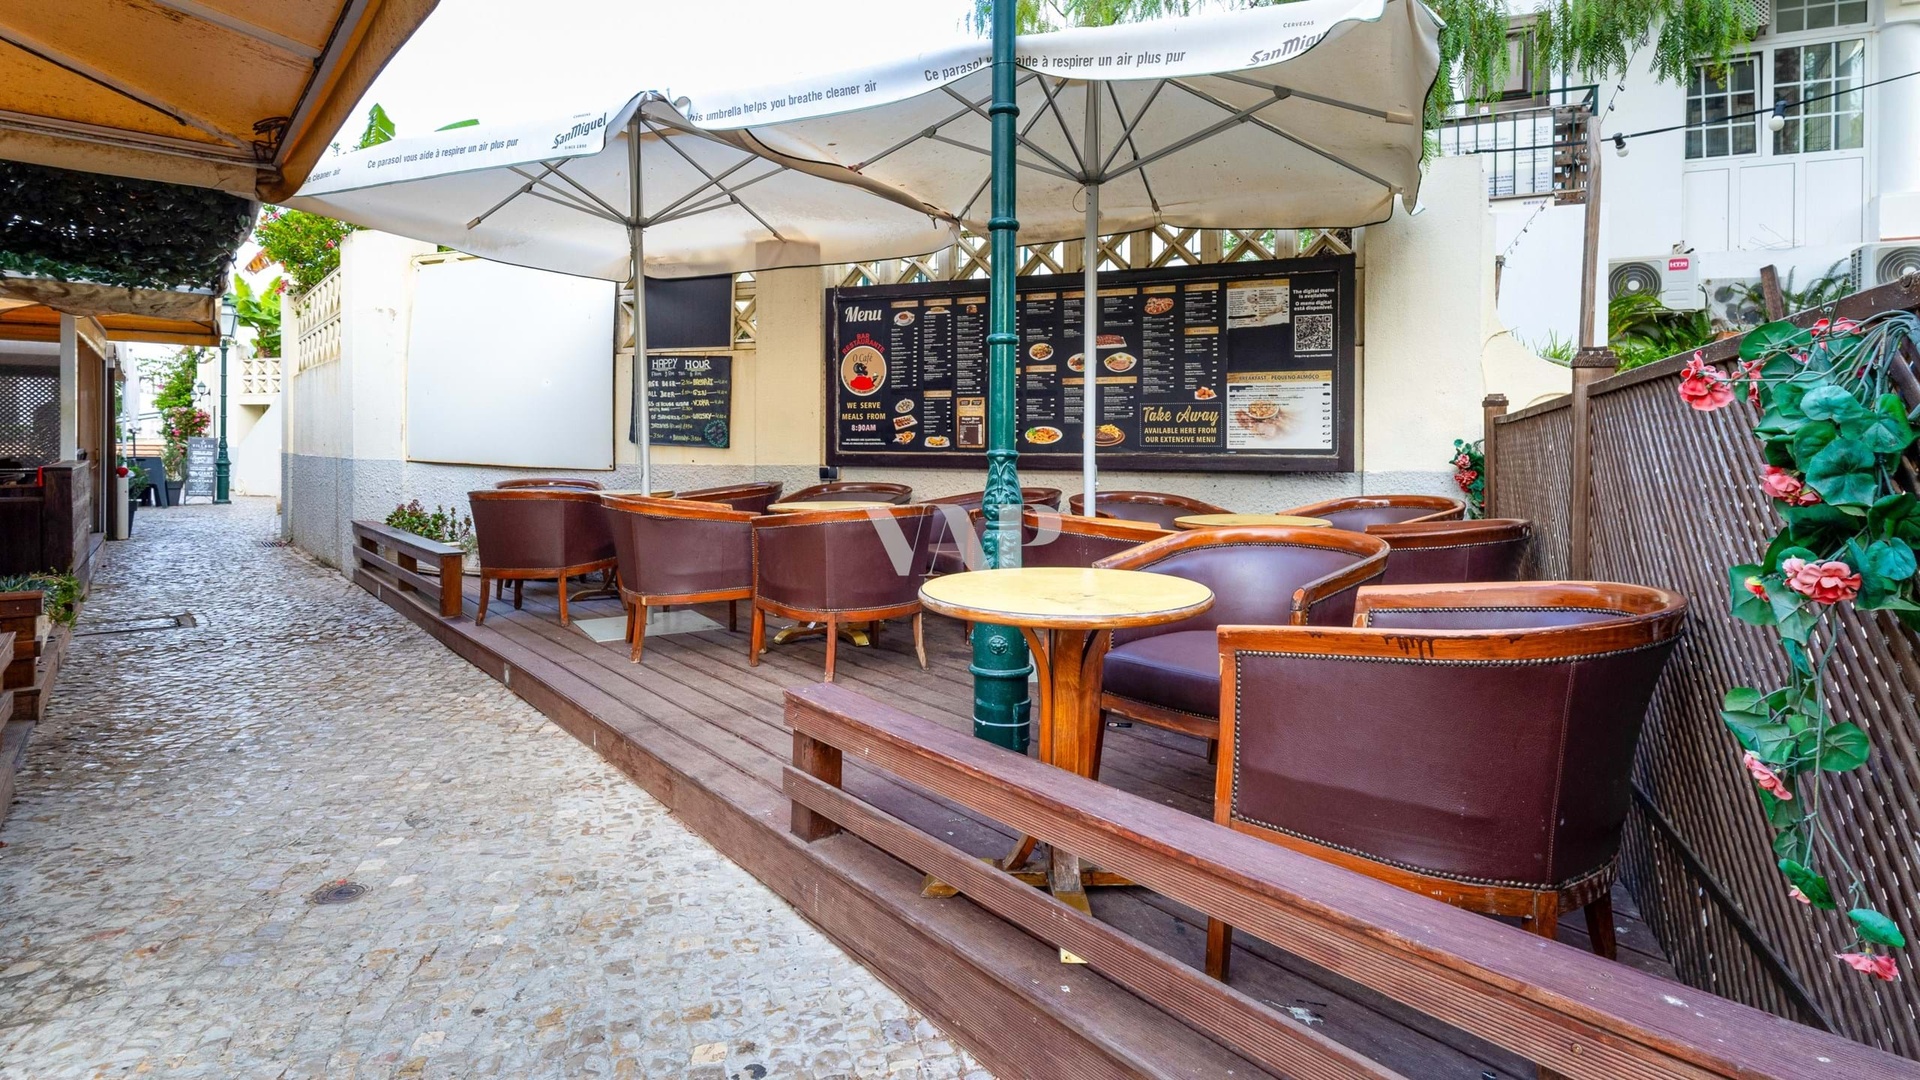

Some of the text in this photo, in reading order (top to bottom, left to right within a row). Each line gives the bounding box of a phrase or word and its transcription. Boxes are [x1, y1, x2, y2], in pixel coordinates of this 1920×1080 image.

[1283, 20, 1315, 28] CERVEZAS
[1246, 31, 1326, 66] SanMig
[1016, 51, 1186, 70] aide à respirer un air plus pur
[924, 60, 983, 82] Ce parasol
[688, 80, 877, 121] his umbrella helps you breathe cleaner air
[551, 112, 607, 150] SanMiguel
[367, 137, 519, 169] Ce parasol vous aide à respirer un air plus pur
[312, 170, 332, 183] cleaner
[333, 167, 341, 176] air
[845, 306, 882, 323] Menu
[856, 333, 871, 341] BAR
[842, 338, 886, 355] RESTAURANTE
[652, 358, 712, 370] HAPPY HOUR
[859, 353, 873, 365] Café
[1142, 405, 1220, 427] Take Away
